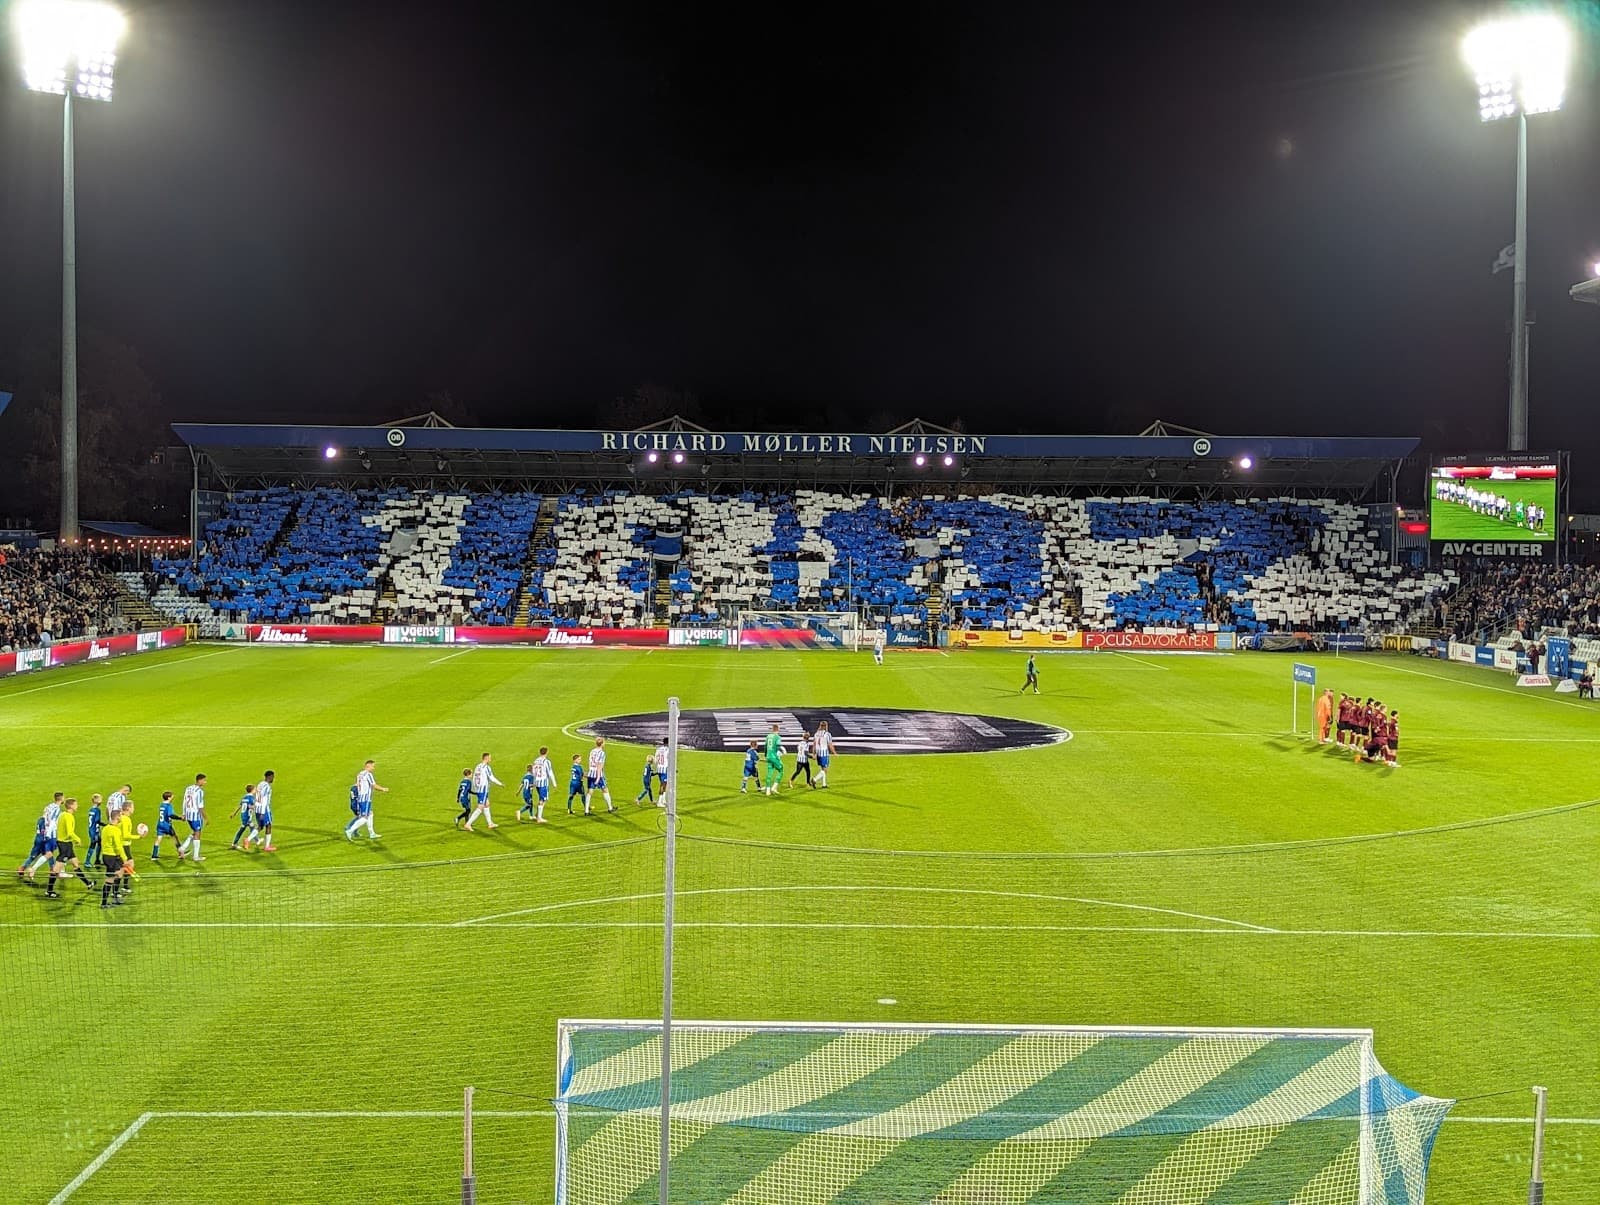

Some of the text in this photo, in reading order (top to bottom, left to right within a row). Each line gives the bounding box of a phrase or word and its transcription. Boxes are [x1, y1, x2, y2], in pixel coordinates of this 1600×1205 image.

[601, 432, 987, 454] RICHARD MØLLER NIELSEN
[256, 626, 308, 642] Albani
[542, 628, 594, 644] Albani
